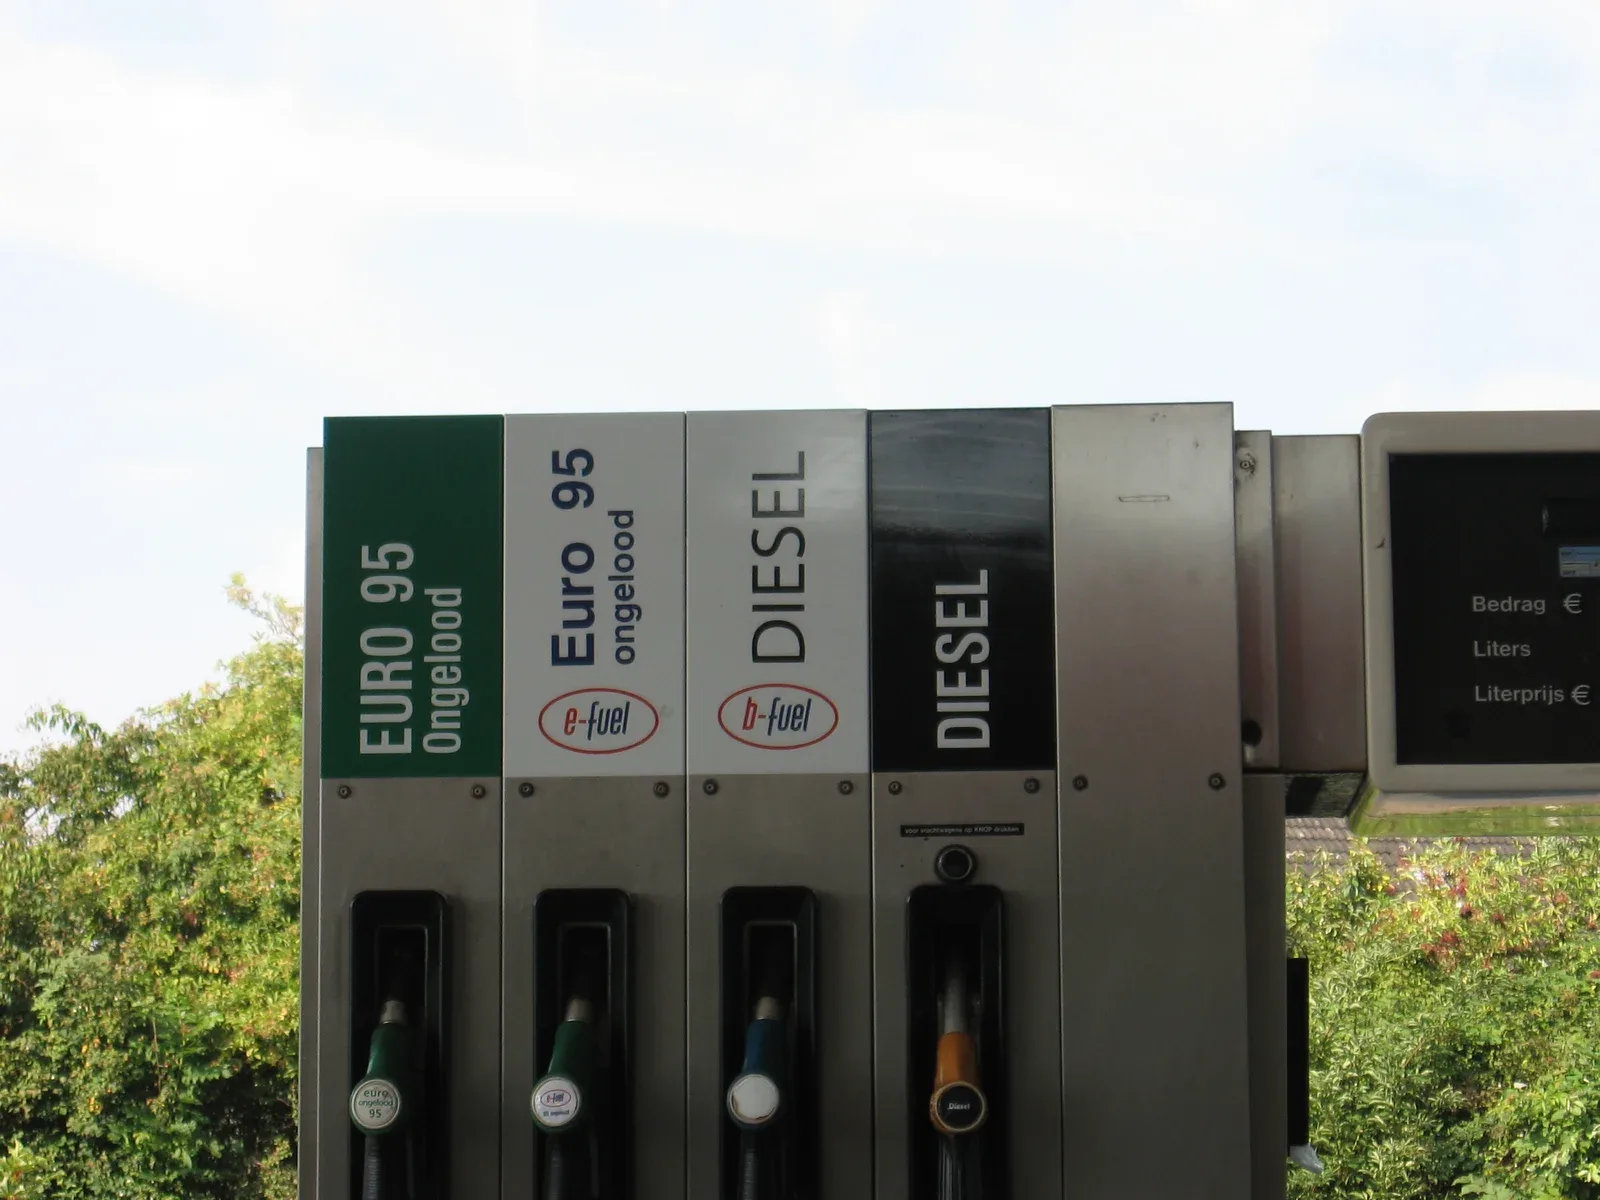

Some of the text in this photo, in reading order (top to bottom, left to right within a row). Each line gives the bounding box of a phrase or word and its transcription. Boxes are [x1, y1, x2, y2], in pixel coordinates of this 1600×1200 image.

[551, 448, 596, 666] Euro 95
[751, 451, 806, 663] DIESEL
[607, 510, 642, 665] ongelood
[1472, 593, 1583, 615] Bedrag €
[359, 542, 415, 754] EURO 95
[935, 569, 991, 748] DIESEL
[1473, 640, 1531, 657] Liters
[422, 588, 470, 754] Ongelood
[1474, 684, 1591, 706] Literprijs €
[563, 701, 630, 741] e-fuel
[741, 696, 812, 737] b-fuel
[363, 1090, 389, 1098] euro
[369, 1109, 382, 1119] 95
[948, 1102, 971, 1110] Diesel
